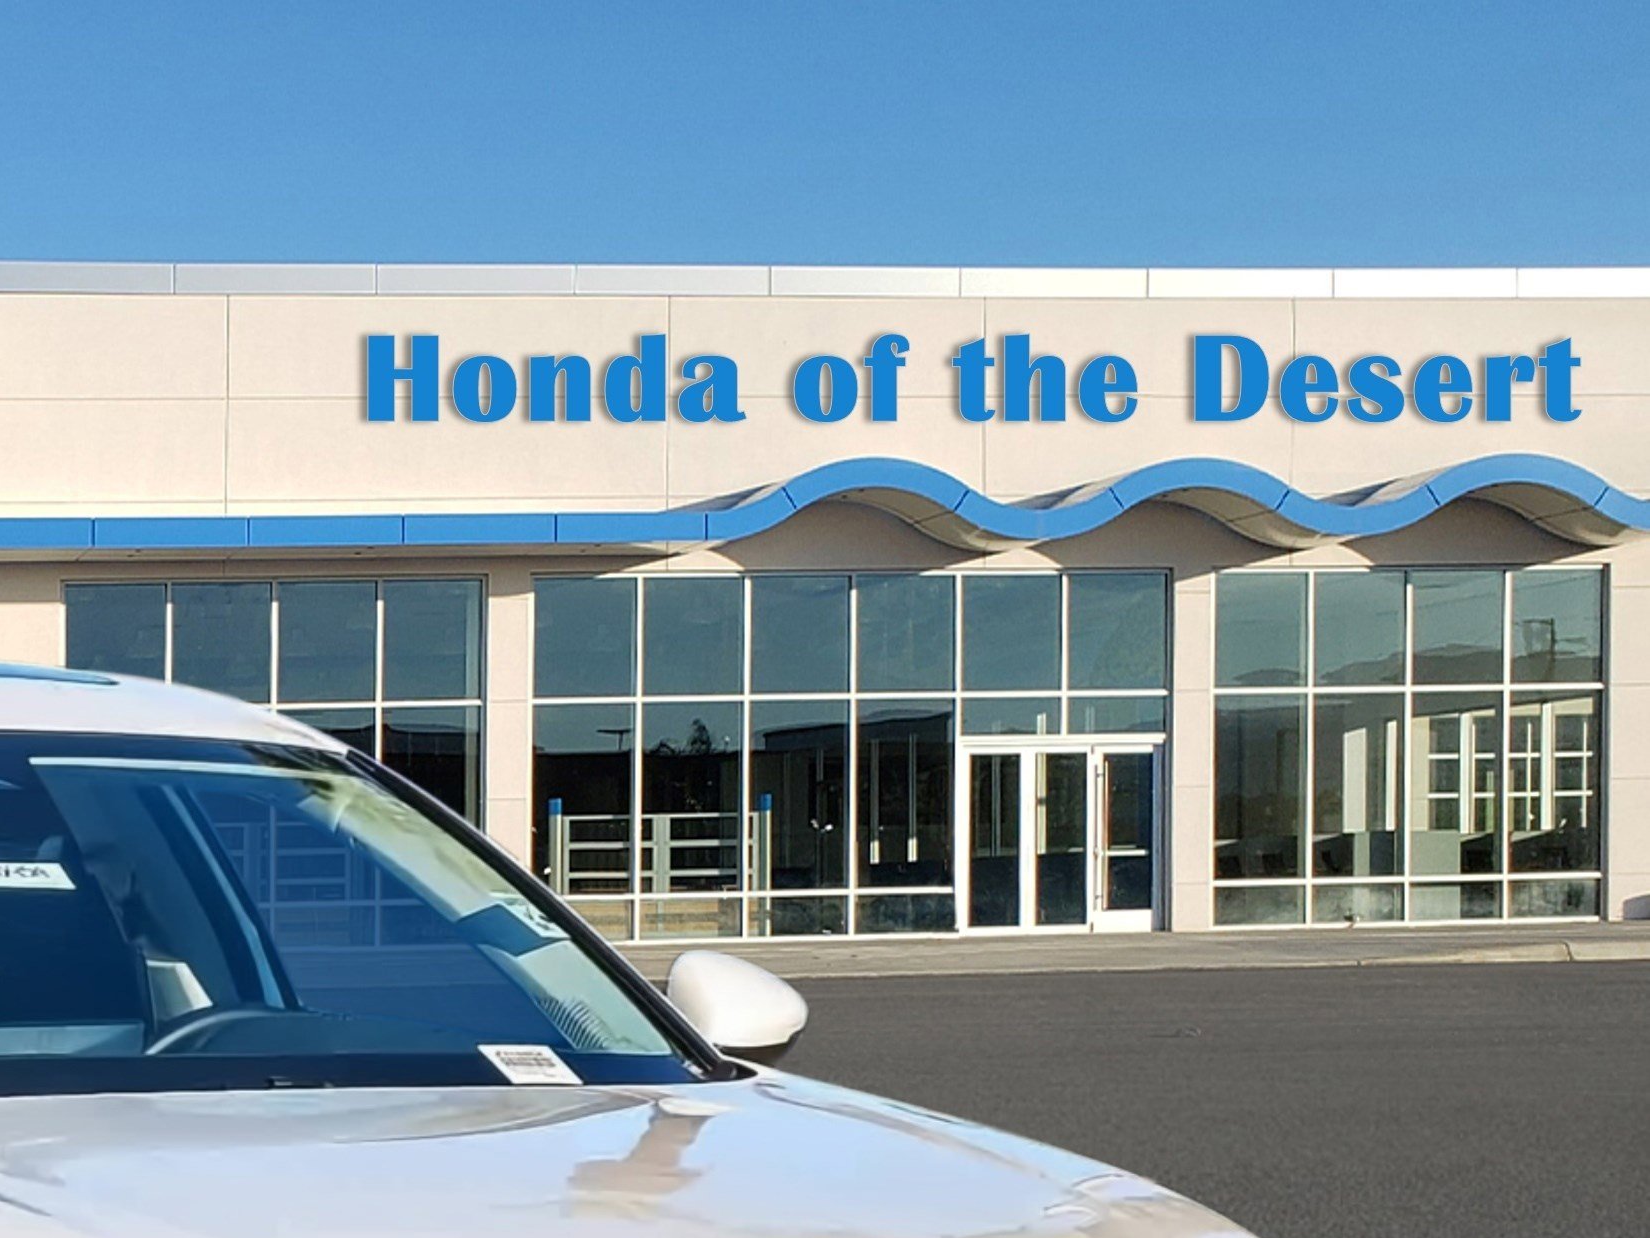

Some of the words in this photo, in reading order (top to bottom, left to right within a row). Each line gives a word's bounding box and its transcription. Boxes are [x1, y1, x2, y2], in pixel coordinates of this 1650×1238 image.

[366, 333, 747, 423] Honda
[793, 333, 910, 423] of
[951, 333, 1138, 423] the
[1193, 334, 1582, 423] Desert
